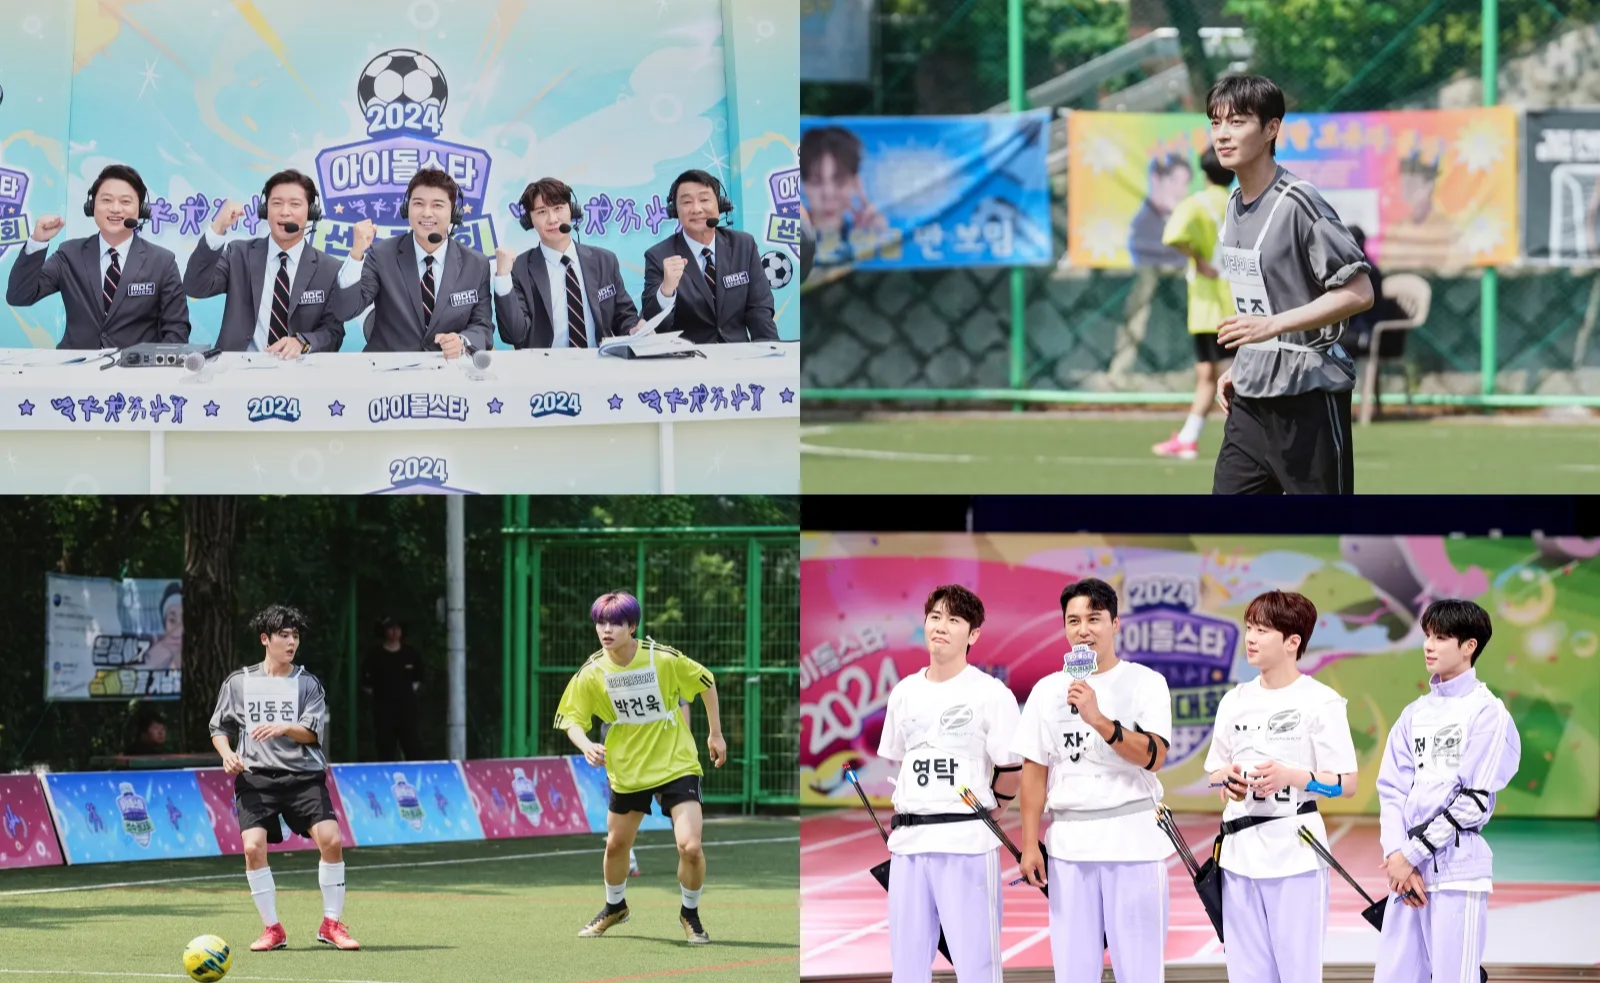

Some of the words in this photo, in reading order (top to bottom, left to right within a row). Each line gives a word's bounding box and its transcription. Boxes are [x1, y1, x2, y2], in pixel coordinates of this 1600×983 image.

[366, 102, 441, 133] 2024
[248, 396, 300, 420] 2024
[369, 393, 469, 422] 아이돌스타
[530, 392, 582, 416] 2024
[390, 457, 448, 483] 2024
[1128, 579, 1197, 608] 2024
[247, 701, 295, 722] 김동준
[614, 694, 660, 718] 박건욱
[800, 655, 900, 755] 2024
[912, 757, 959, 787] 영탁
